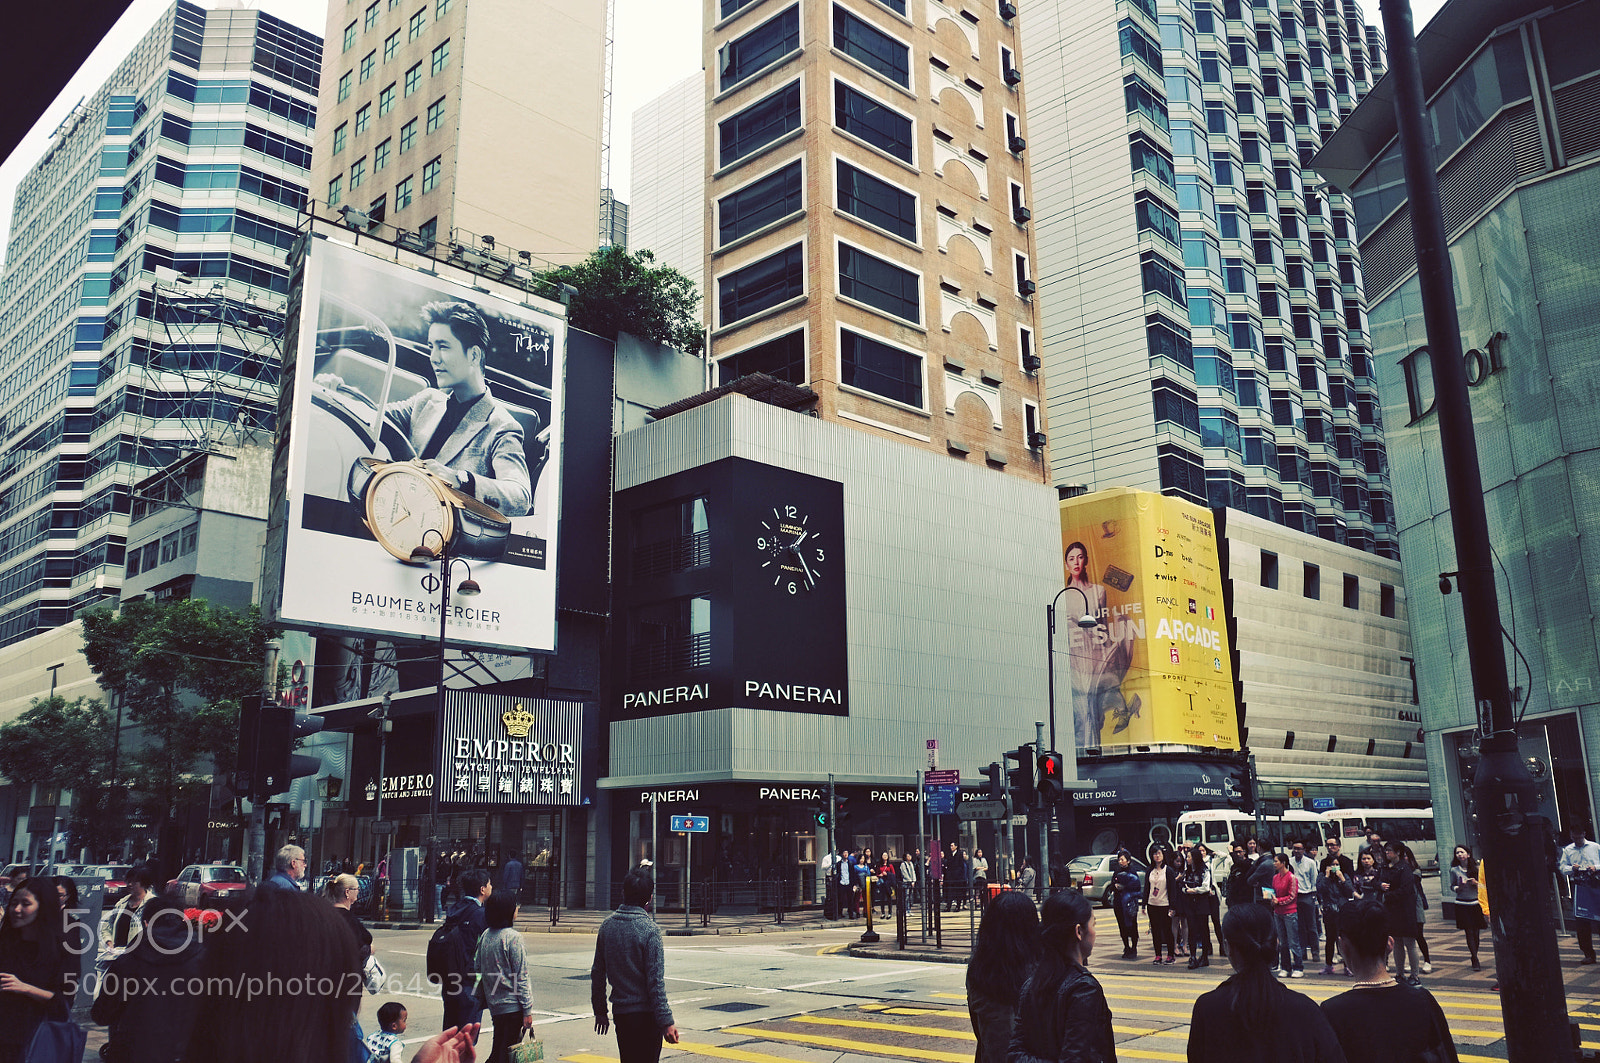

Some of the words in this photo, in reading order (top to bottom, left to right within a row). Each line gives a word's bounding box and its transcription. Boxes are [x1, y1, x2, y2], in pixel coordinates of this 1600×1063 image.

[1396, 331, 1508, 428] Dor
[785, 505, 797, 519] 12
[780, 523, 803, 532] LUMINOR
[780, 528, 802, 536] MARINA
[757, 537, 766, 550] 9
[816, 548, 825, 562] 3
[780, 564, 804, 573] PANERAI
[787, 581, 797, 594] 6
[1112, 602, 1142, 617] LIFE
[1092, 618, 1146, 646] SUN
[1155, 618, 1222, 652] ARCADE
[623, 683, 709, 709] PANERAI
[745, 680, 842, 705] PANERAI
[1398, 710, 1421, 722] GALL
[455, 737, 575, 764] EMPEROR
[455, 762, 490, 772] WATCH
[495, 765, 515, 774] AND
[521, 766, 575, 776] JEWELLERY
[381, 773, 434, 792] EMPERO
[411, 789, 433, 797] JEWELL
[759, 788, 821, 800] PANERA
[1072, 792, 1094, 801] QUET
[1095, 790, 1117, 799] DROZ
